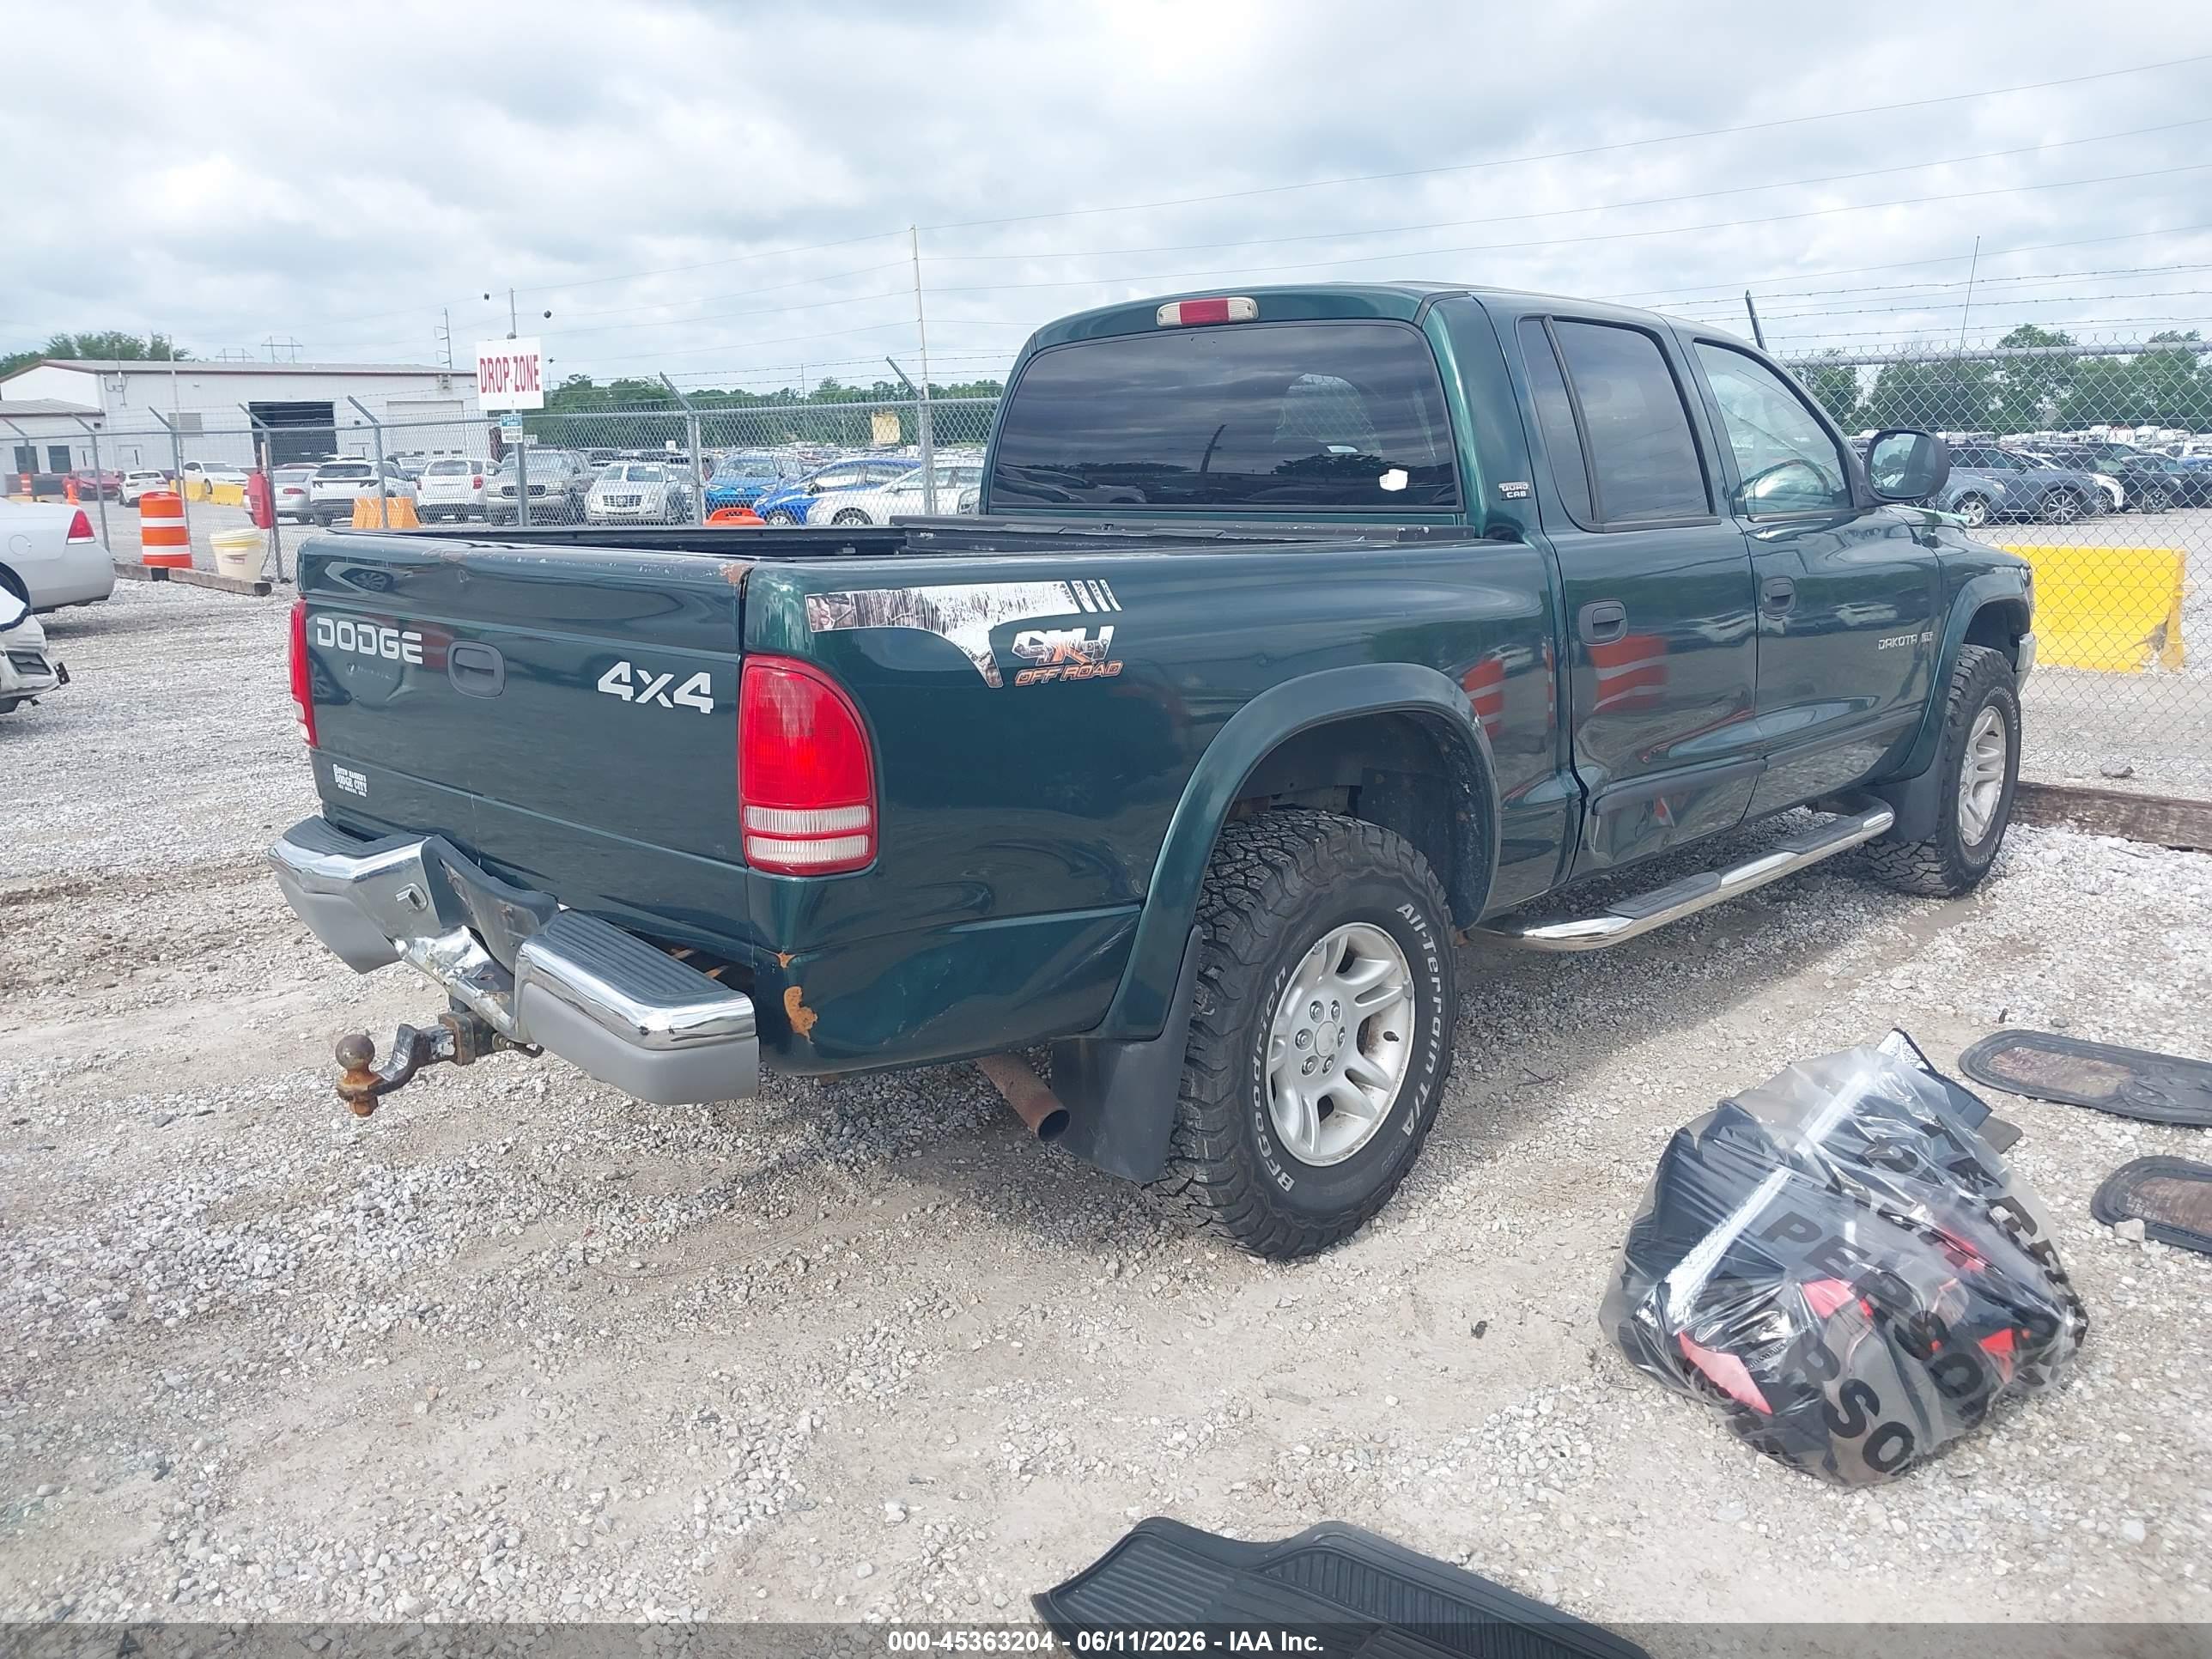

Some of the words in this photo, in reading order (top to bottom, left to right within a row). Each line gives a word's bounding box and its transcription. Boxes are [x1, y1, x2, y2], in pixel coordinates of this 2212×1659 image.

[479, 356, 510, 393] DROP
[513, 354, 540, 392] ZONE
[316, 617, 423, 665] DODGE
[1878, 635, 1917, 650] DAKOTA
[1014, 666, 1062, 686] OFF
[1059, 659, 1123, 682] ROAD
[354, 779, 368, 793] CITY
[1395, 902, 1443, 1074] All-Terrain
[1253, 966, 1294, 1192] BFGoodrich
[1401, 1082, 1431, 1137] T/A
